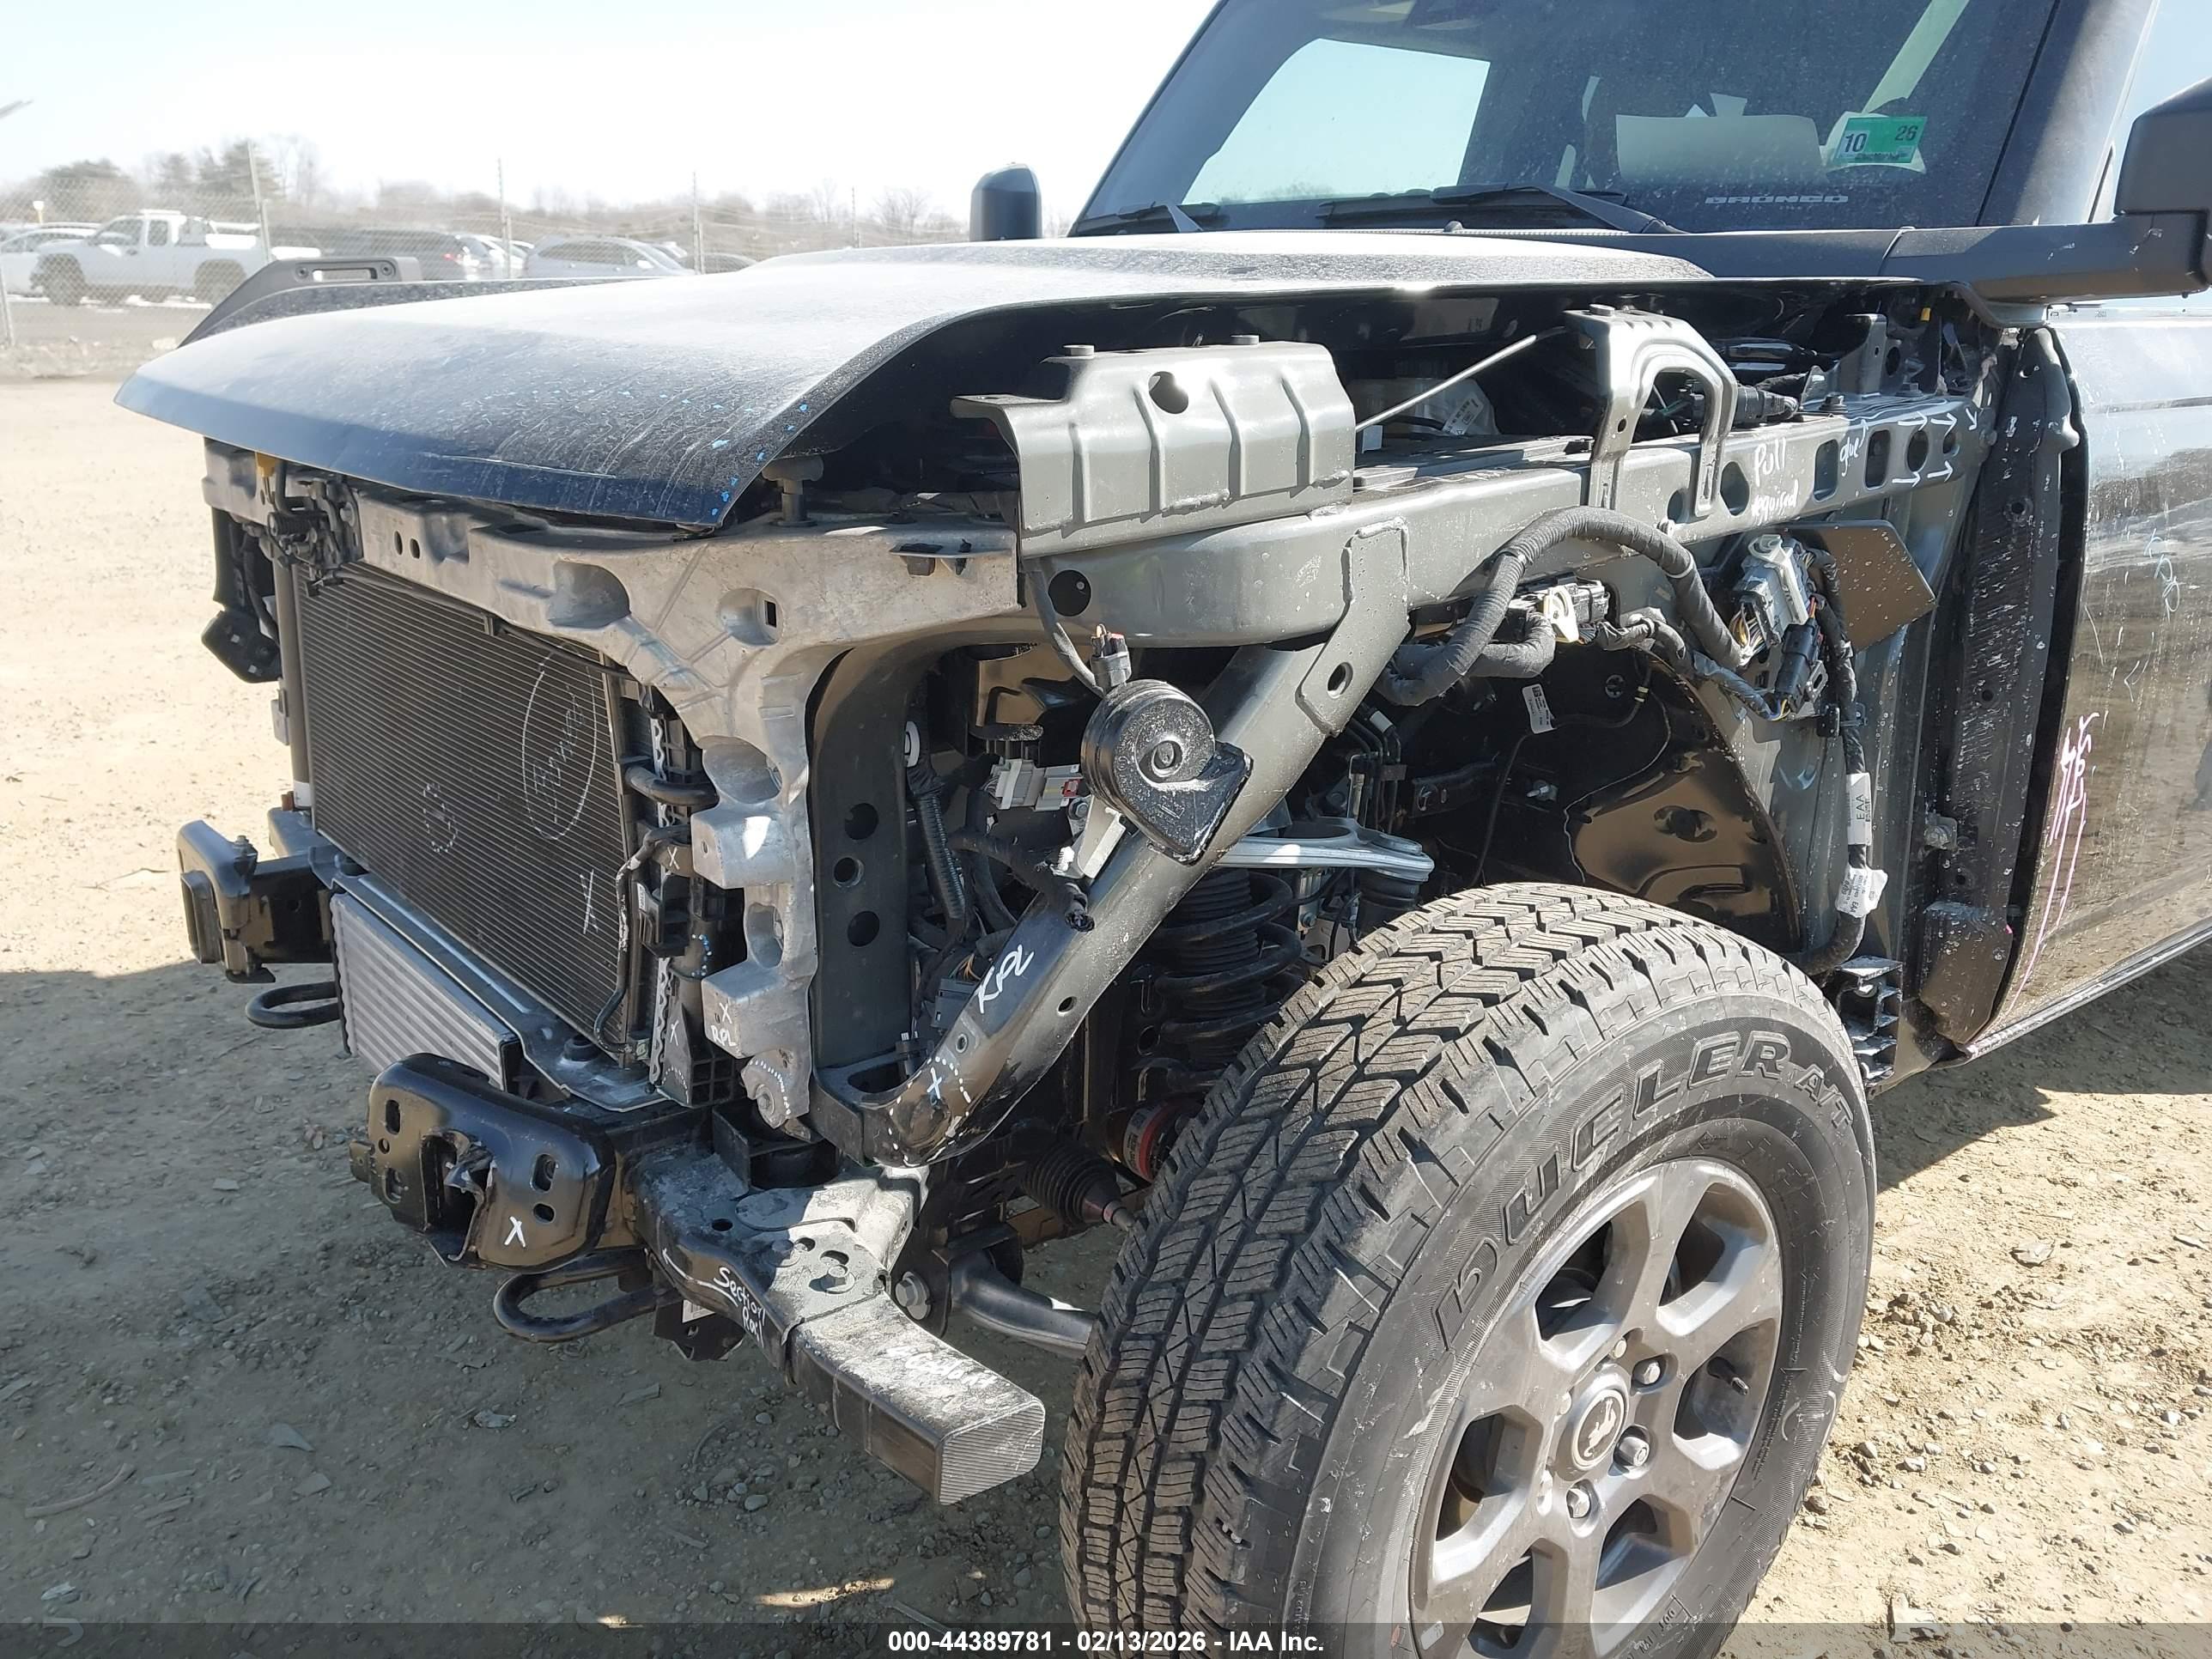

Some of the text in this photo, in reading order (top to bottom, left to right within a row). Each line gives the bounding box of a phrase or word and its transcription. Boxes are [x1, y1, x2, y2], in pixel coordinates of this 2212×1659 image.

[1844, 125, 1918, 153] 10 26
[1705, 195, 1849, 204] BRONCO
[1754, 437, 1787, 487] Pull
[1856, 793, 1865, 821] EAA
[1431, 1030, 1794, 1350] DUELER
[713, 1266, 767, 1327] Section
